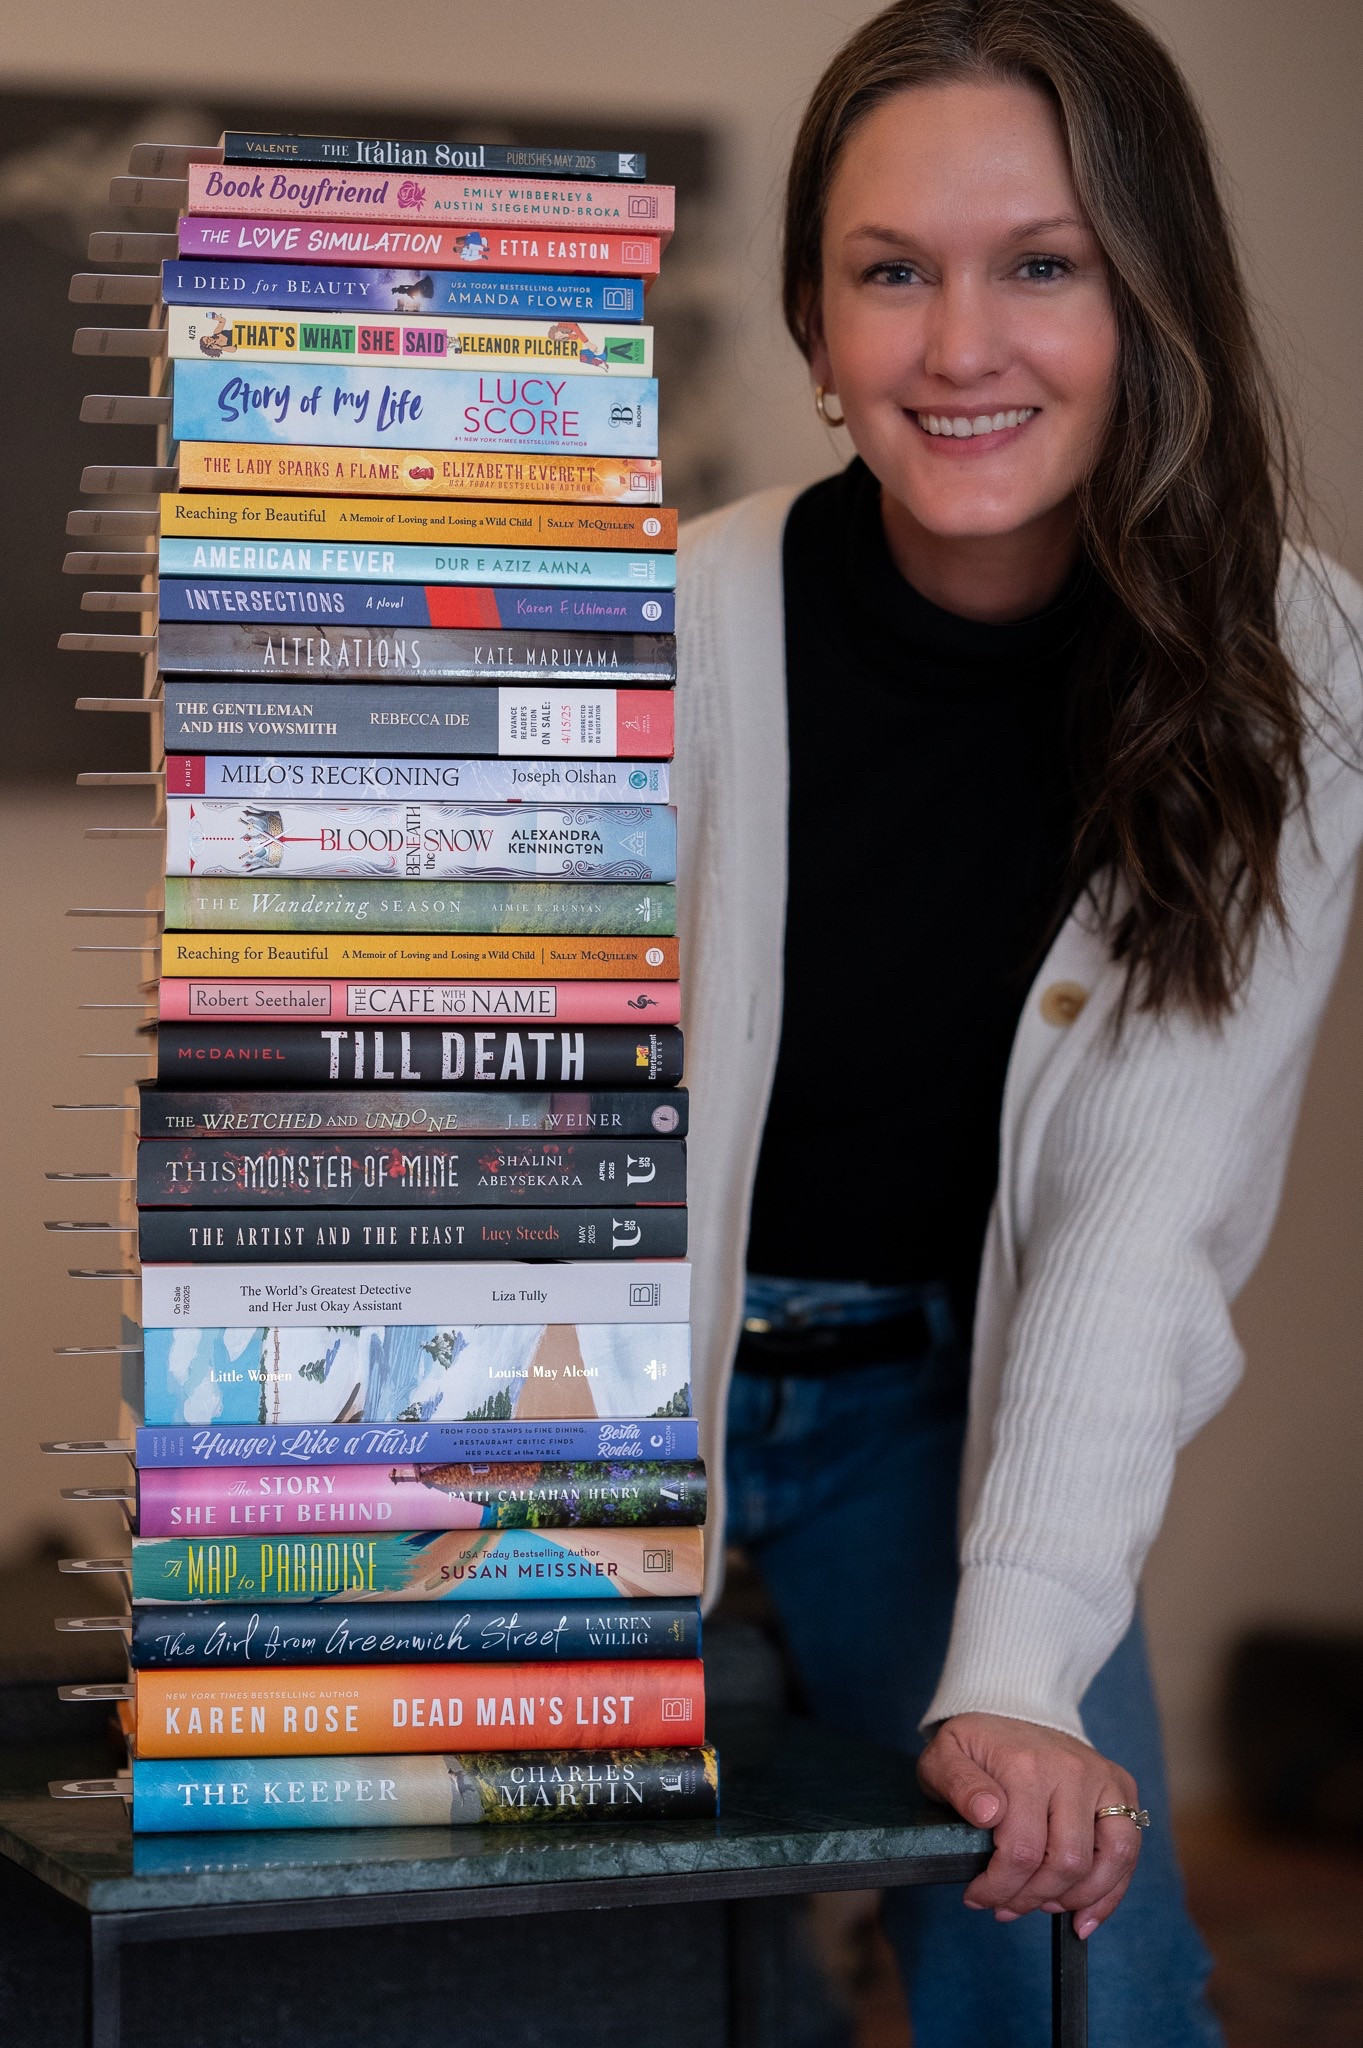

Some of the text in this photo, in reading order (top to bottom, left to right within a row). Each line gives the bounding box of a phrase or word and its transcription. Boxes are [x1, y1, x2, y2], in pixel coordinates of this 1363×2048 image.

[322, 141, 485, 168] THE Italian Soul
[206, 171, 388, 208] Book Boyfriend
[464, 188, 593, 202] EMILY WIBBERLEY &
[434, 201, 620, 217] AUSTIN SIEGEMUND-BROKA
[201, 229, 230, 244] THE
[307, 230, 442, 255] SIMULATION
[500, 240, 609, 260] ETTA EASTON
[177, 275, 371, 296] I DIED for BEAUTY
[448, 292, 594, 308] AMANDA FLOWER
[234, 324, 444, 353] THAT'S WHAT SHE SAID
[463, 338, 578, 356] ELEANOR PILCHER
[479, 378, 566, 406] LUCY
[218, 377, 424, 432] Story of my Life
[463, 406, 580, 437] SCORE
[204, 458, 399, 480] THE LADY SPARKS A FLAME
[443, 462, 596, 482] ELIZABETH EVERETT
[175, 506, 326, 524] Reaching for Beautiful
[193, 546, 396, 573] AMERICAN FEVER
[436, 558, 591, 574] DUR E AZIZ AMNA
[185, 589, 345, 613] INTERSECTIONS
[264, 637, 421, 668] ALTERATIONS
[474, 647, 618, 668] KATE MARUYAMA
[176, 703, 313, 717] THE GENTLEMAN
[370, 712, 470, 726] REBECCA IDE
[180, 722, 337, 735] AND HIS VOWSMITH
[560, 704, 571, 744] 4/15/25
[222, 765, 460, 787] MILO'S RECKONING
[512, 768, 617, 786] Joseph Olshan
[320, 829, 494, 852] BLOOD SNOW
[405, 805, 421, 876] BENEATH
[511, 830, 601, 841] ALEXANDRA
[509, 843, 604, 854] KENNINGTON
[424, 852, 436, 870] the
[197, 893, 462, 920] THE Wandering SEASON
[196, 990, 326, 1007] Robert Seethaler
[354, 986, 550, 1013] THE CAFÉ WITH NO NAME
[321, 1031, 585, 1081] TILL DEATH
[498, 1156, 562, 1166] SHALINI
[165, 1155, 459, 1188] THIS MONSTER OF MINE
[478, 1175, 583, 1186] ABEYSEKARA
[190, 1226, 465, 1246] THE ARTIST AND THE FEAST
[482, 1226, 560, 1245] Lucy Steeds
[240, 1284, 412, 1296] The World's Greatest Detective
[492, 1290, 547, 1303] Liza Tully
[248, 1300, 402, 1314] and Her Just Okay Assistant
[489, 1365, 599, 1380] Louisa May Alcott
[192, 1428, 429, 1460] Hunger Like a Thirst
[228, 1476, 336, 1496] The STORY
[170, 1502, 392, 1525] SHE LEFT BEHIND
[162, 1542, 377, 1594] A MAP to PARADISE
[440, 1562, 618, 1580] SUSAN MEISSNER
[586, 1617, 652, 1630] LAUREN
[155, 1612, 570, 1660] The Girl from Greenwich Street
[589, 1632, 648, 1645] WILLIG
[166, 1705, 358, 1734] KAREN ROSE
[392, 1696, 634, 1727] DEAD MAN'S LIST
[510, 1764, 635, 1784] CHARLES
[177, 1779, 398, 1806] THE KEEPER
[499, 1781, 646, 1807] MARTIN
